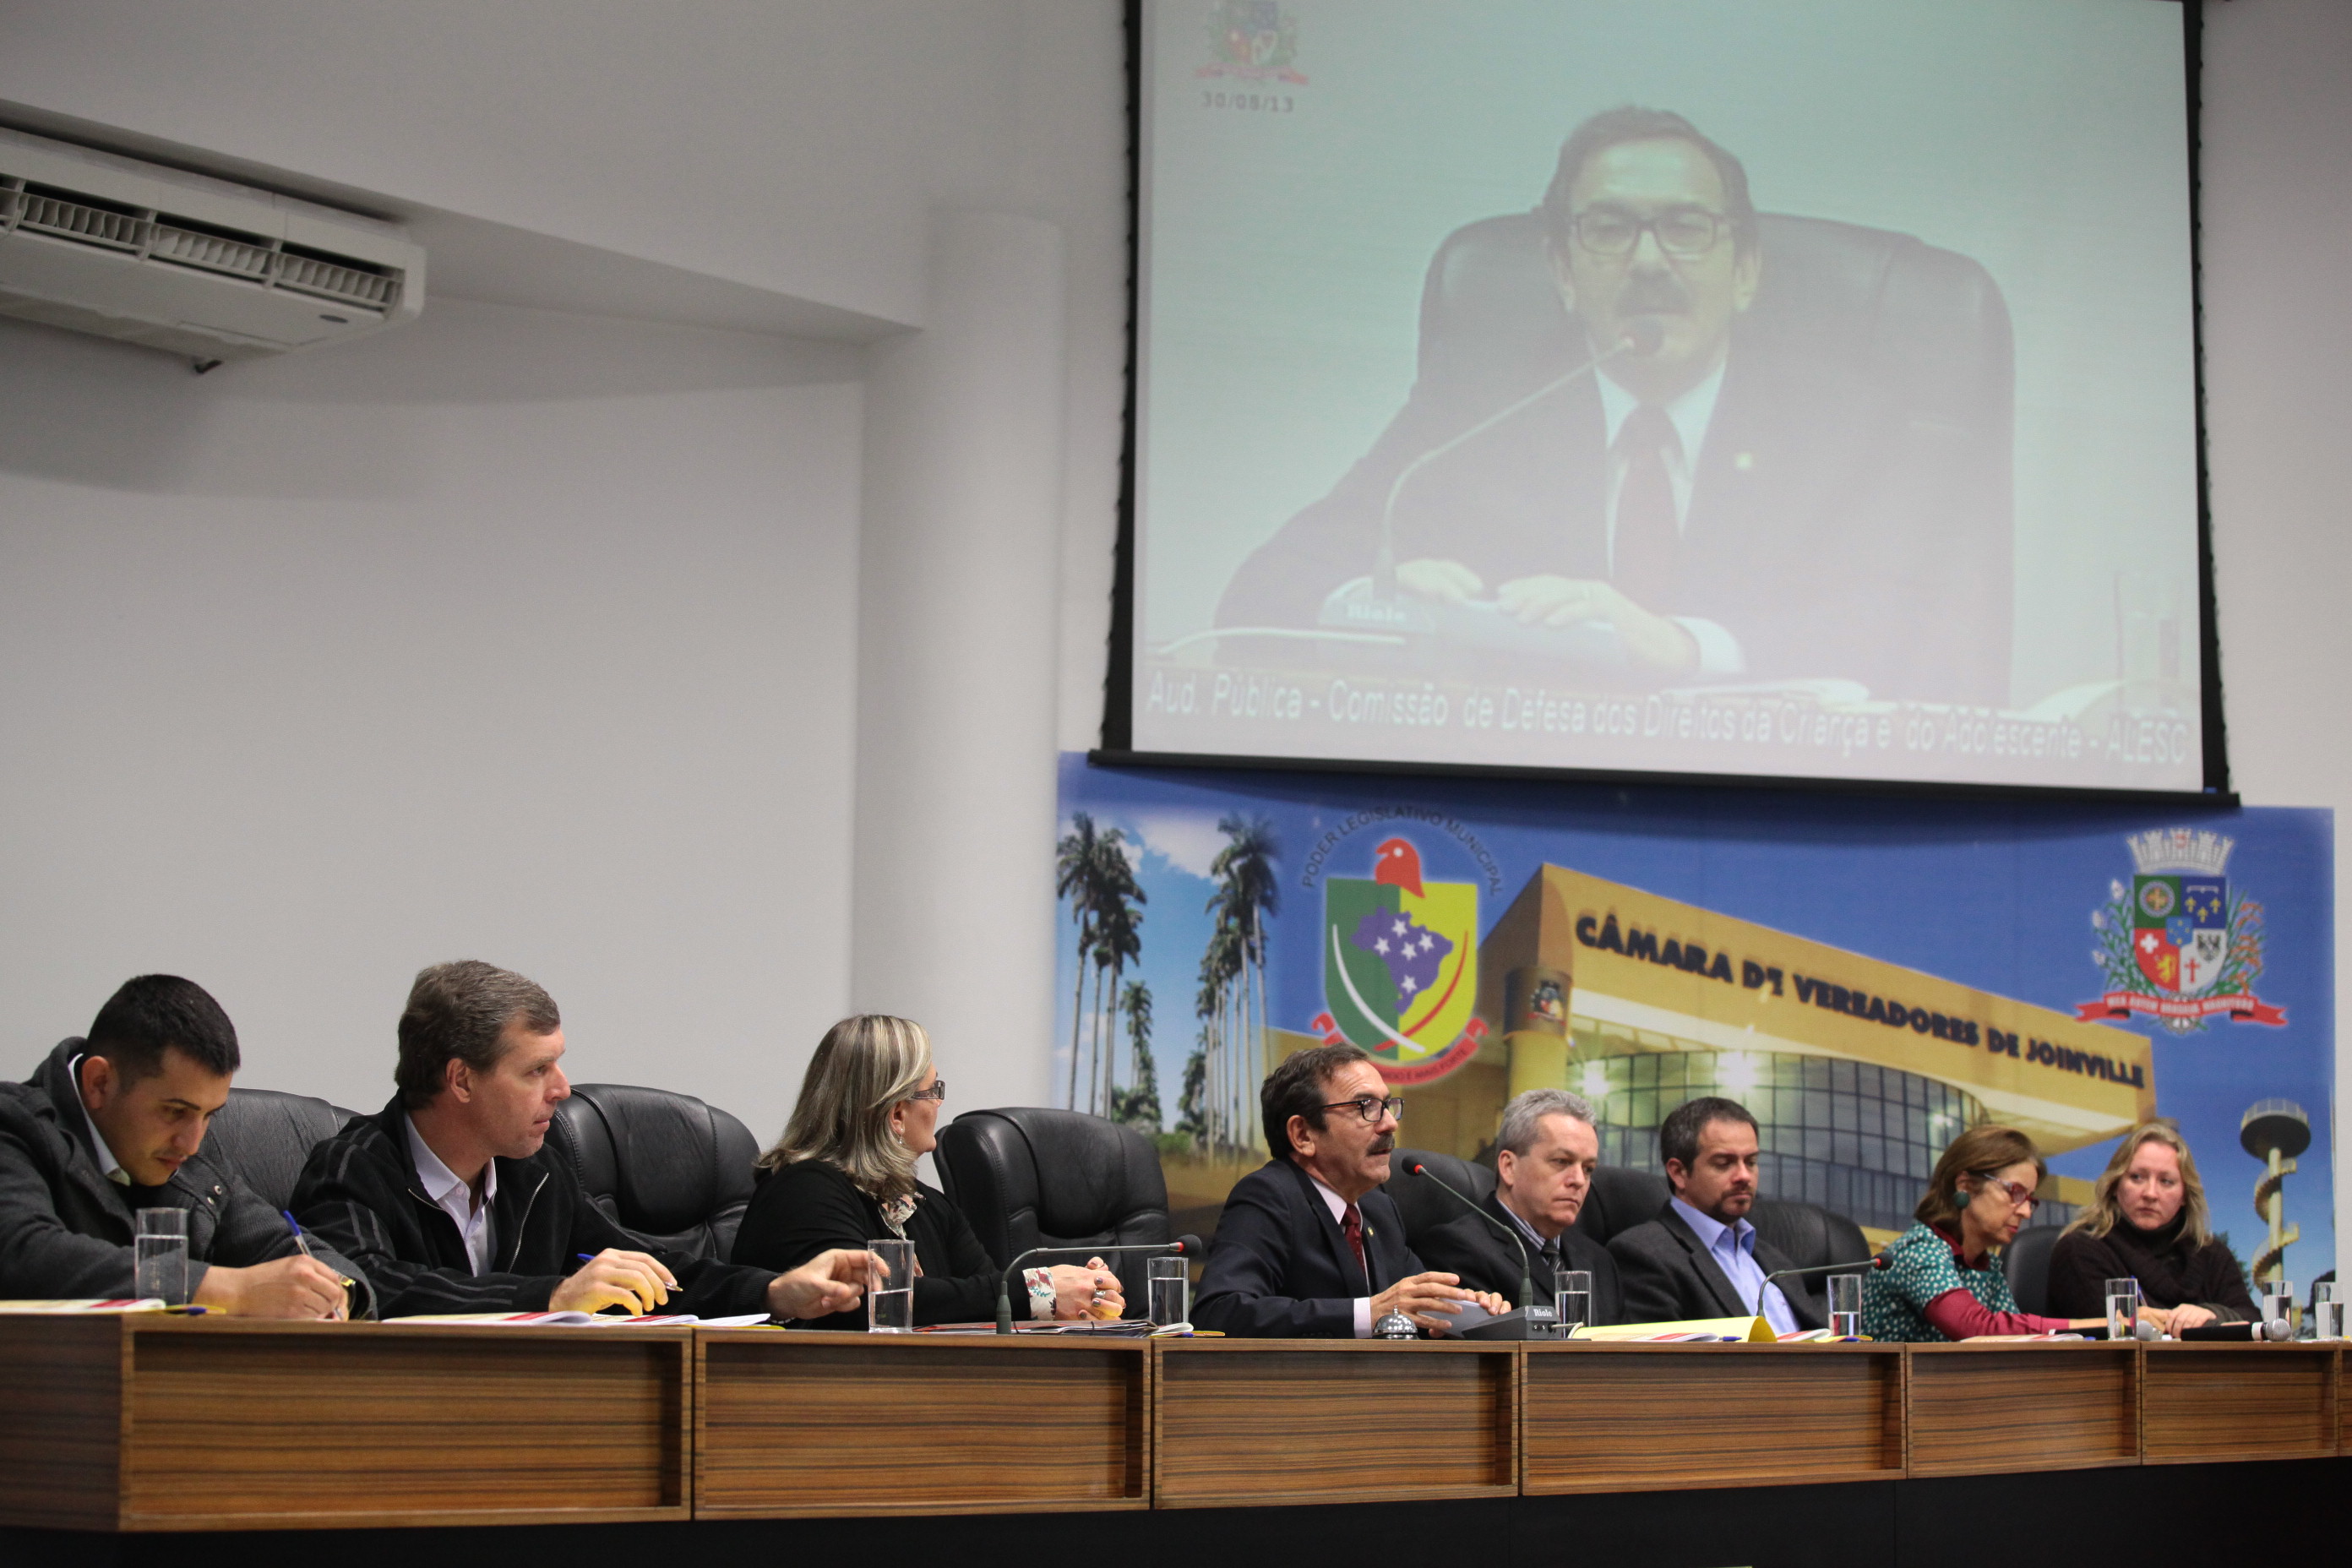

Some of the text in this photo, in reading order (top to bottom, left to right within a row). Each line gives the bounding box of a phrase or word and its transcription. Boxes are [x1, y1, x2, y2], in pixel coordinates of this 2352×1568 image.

[1328, 679, 1448, 727] Comissão
[1463, 687, 1494, 728] de
[1500, 688, 1586, 732] Defesa
[1593, 693, 1637, 735] dos
[1643, 694, 1736, 741] Direitos
[1740, 701, 1772, 743] da
[1779, 701, 1870, 758] Criança
[1876, 717, 1892, 749] e
[1905, 708, 1936, 750] do
[1941, 711, 2082, 759] Adolescente
[2105, 717, 2187, 764] ALESC
[1302, 806, 1502, 897] PODER LEGISLATIVO MUNICIPAL
[1575, 913, 1734, 984] CÂMARA
[1792, 974, 1980, 1047] VEREADORES
[1988, 1027, 2021, 1059] DE
[2026, 1037, 2145, 1089] JOINVILLE
[1533, 1308, 1553, 1317] Riole
